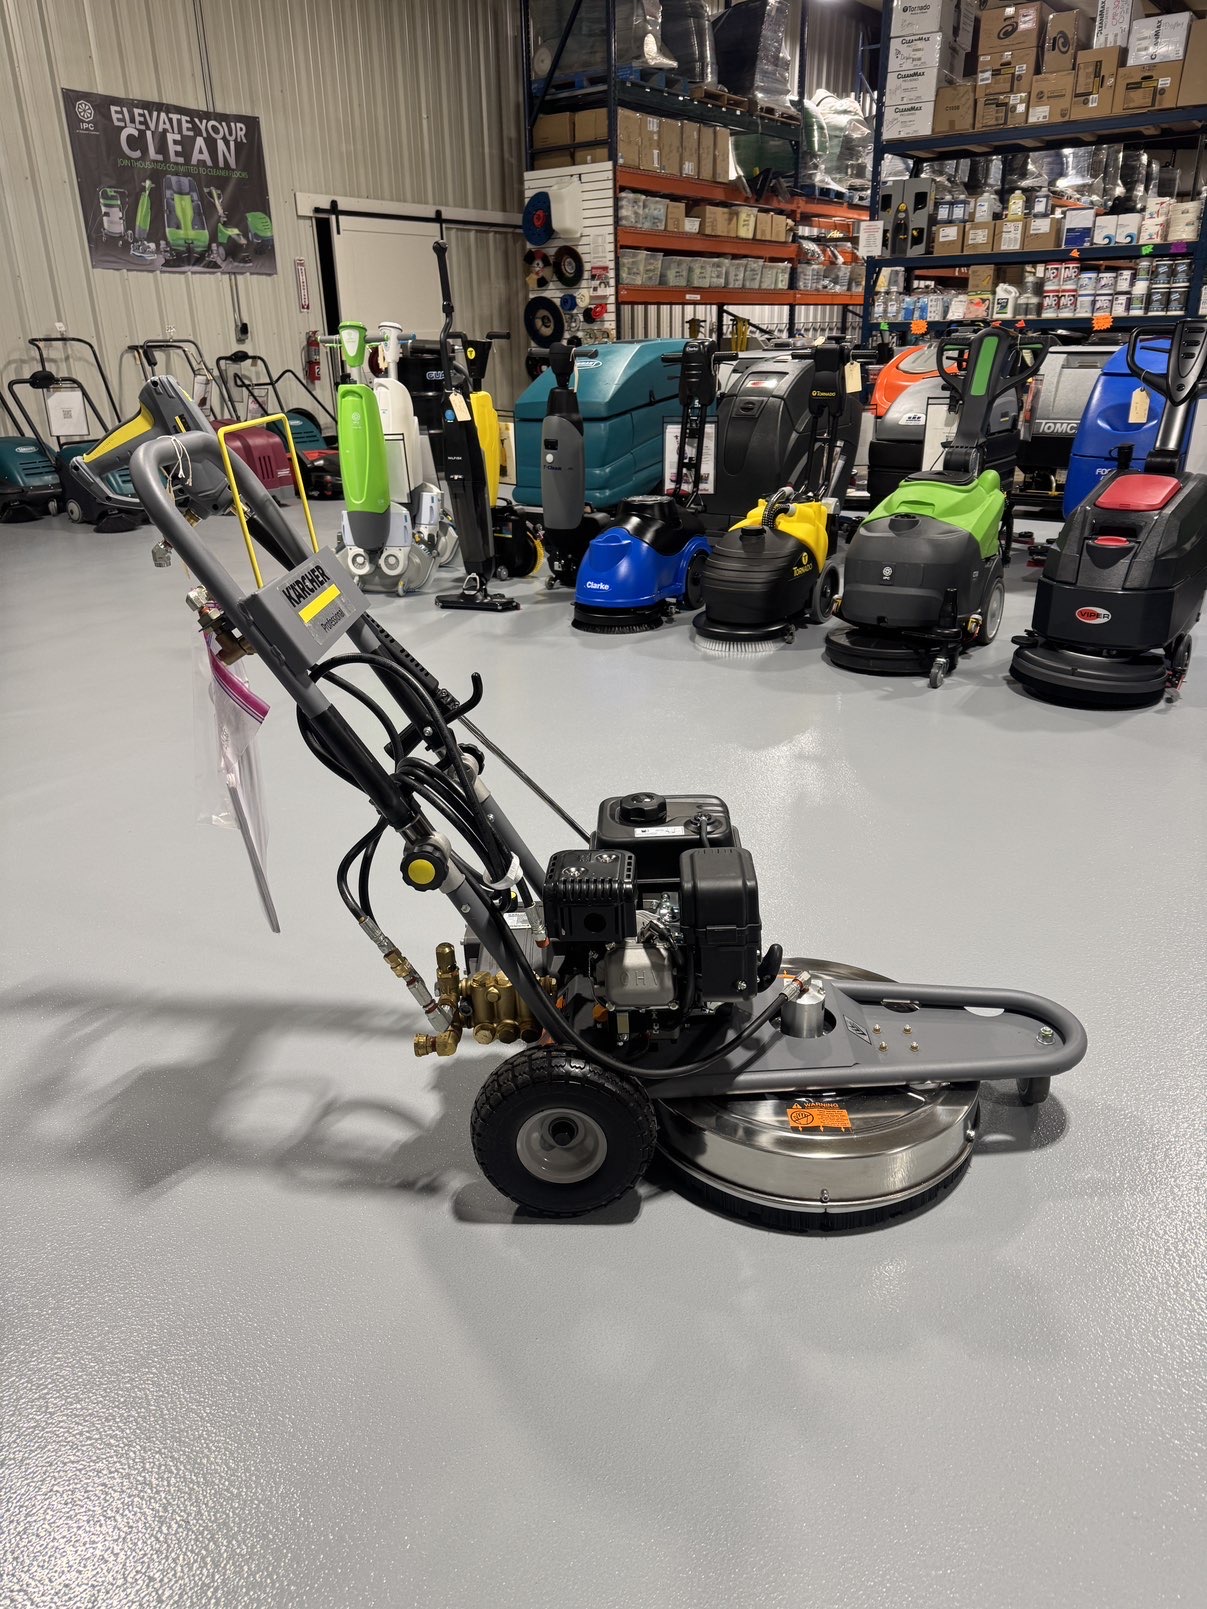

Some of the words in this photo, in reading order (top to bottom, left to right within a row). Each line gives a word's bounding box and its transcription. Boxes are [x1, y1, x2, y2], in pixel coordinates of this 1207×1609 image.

[80, 122, 94, 130] IPC
[110, 105, 194, 136] ELEVATE
[193, 118, 247, 143] YOUR
[120, 127, 236, 169] CLEAN
[117, 158, 131, 167] JOIN
[130, 159, 166, 171] THOUSANDS
[199, 166, 206, 175] TO
[282, 565, 330, 608] KÄRCHER
[586, 580, 610, 590] Clarke
[320, 607, 345, 633] Professional
[1080, 611, 1110, 619] VIPER
